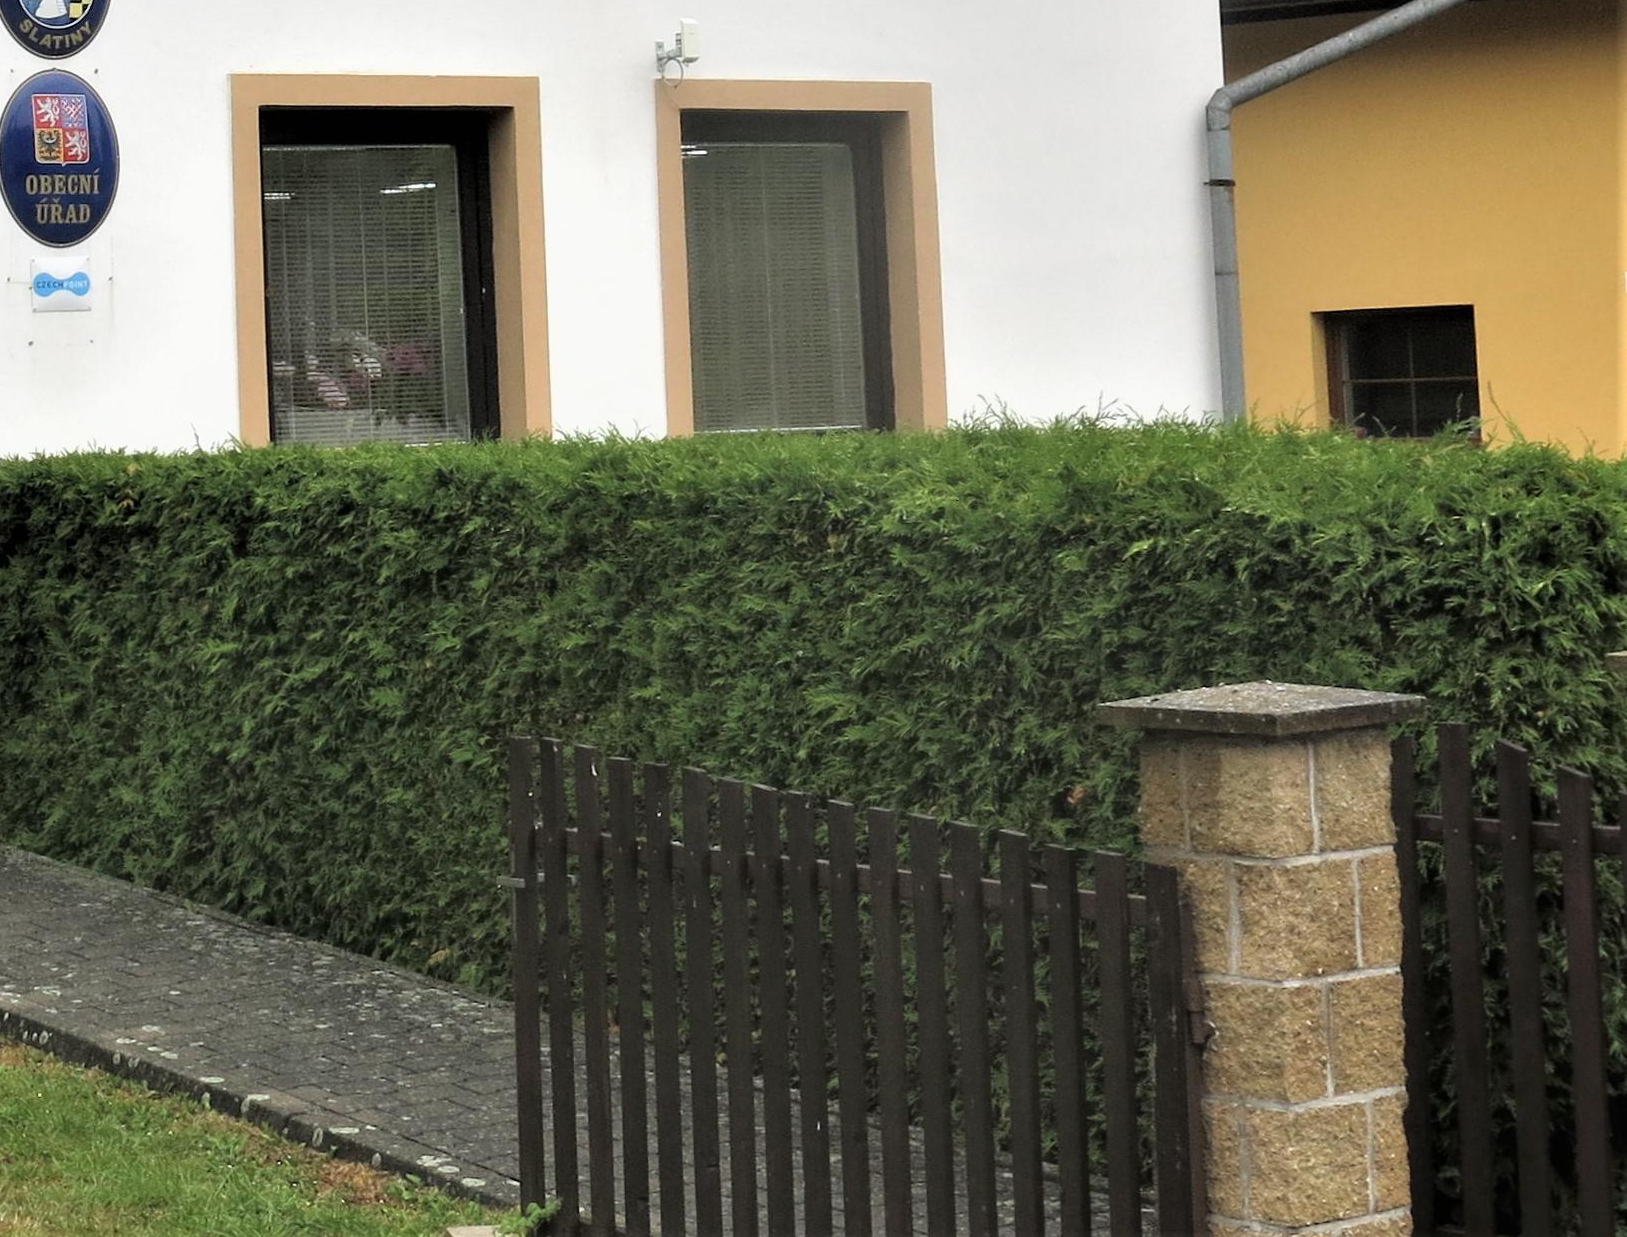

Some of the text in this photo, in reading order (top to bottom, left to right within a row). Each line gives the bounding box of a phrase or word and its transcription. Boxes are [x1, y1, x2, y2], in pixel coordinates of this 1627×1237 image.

[19, 19, 92, 49] SLATINY
[25, 168, 100, 195] OBECNÍ
[36, 197, 91, 224] ÚŘAD
